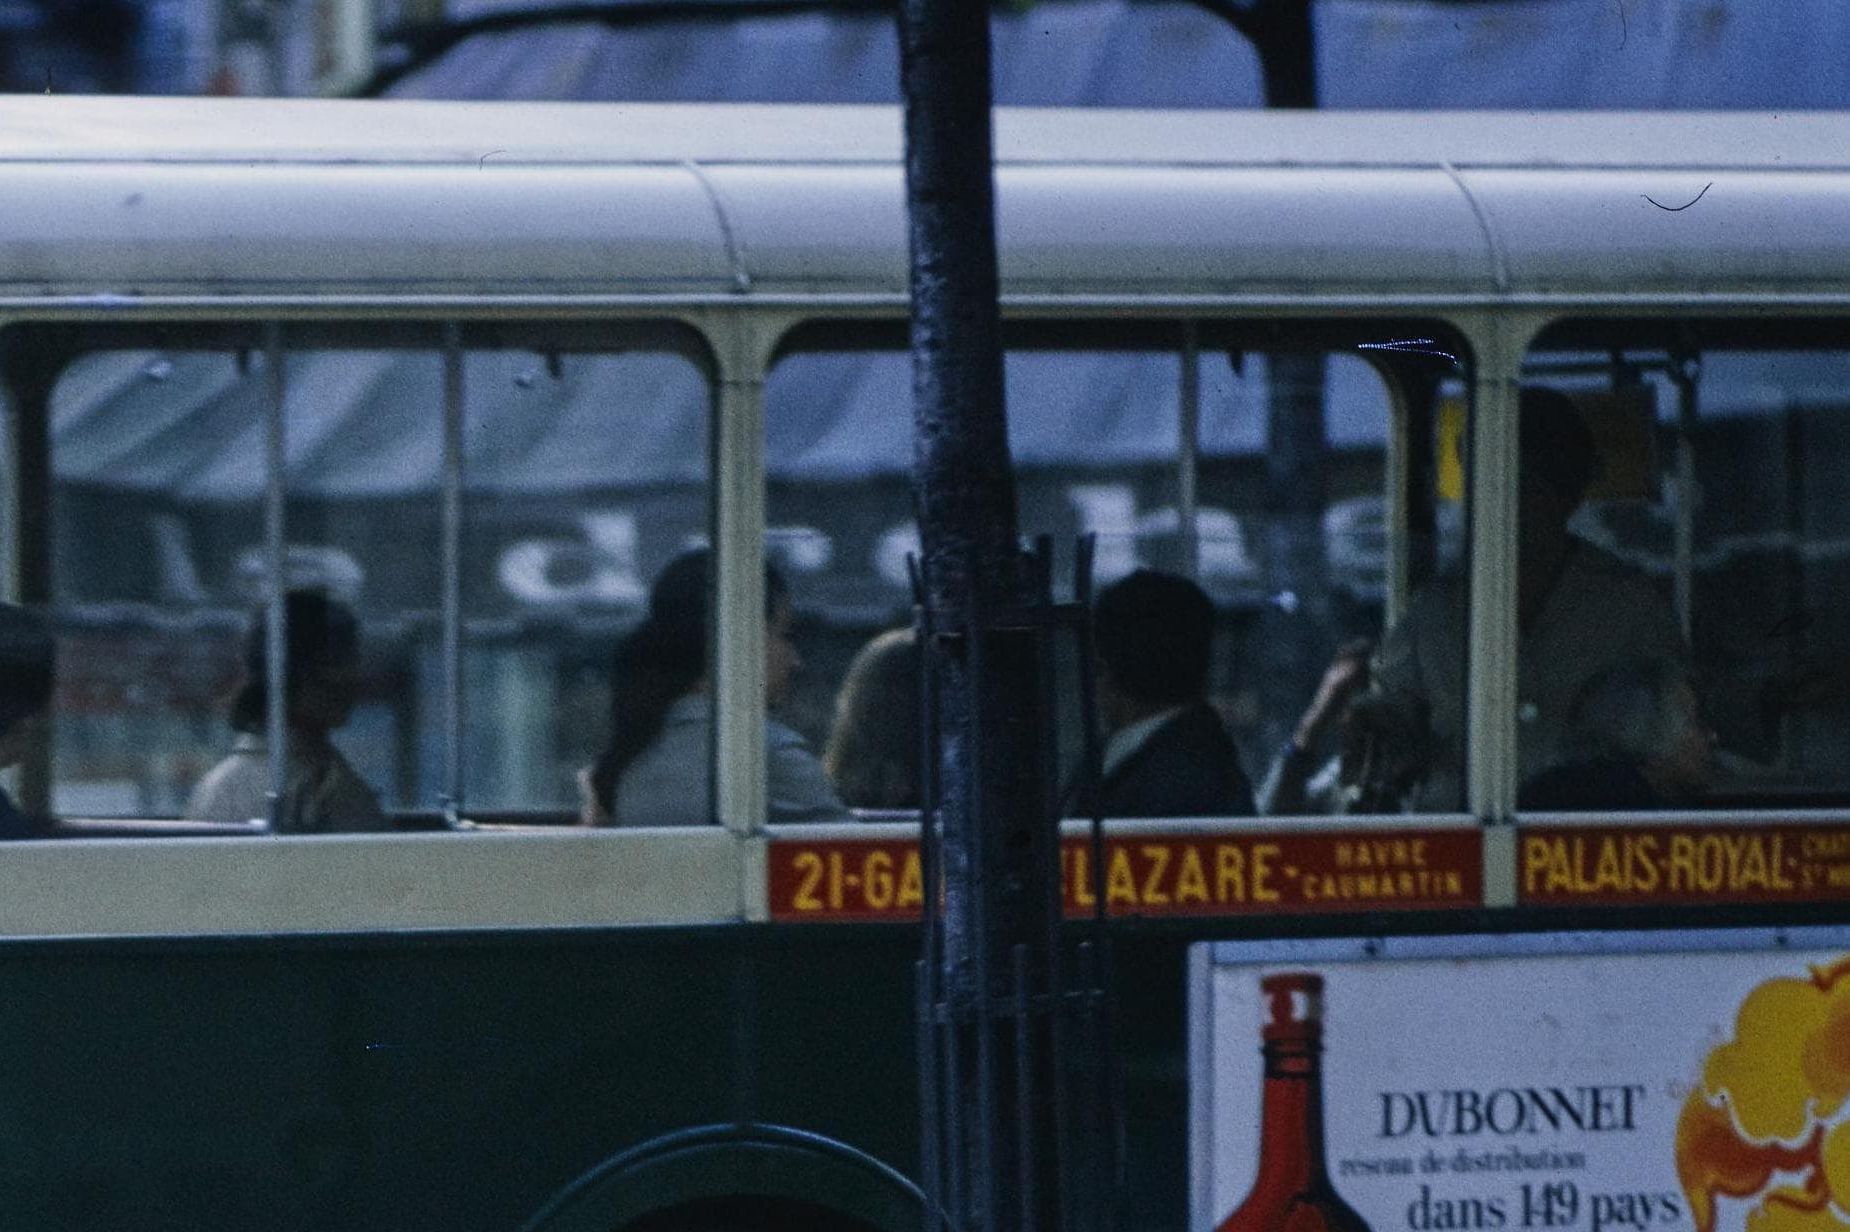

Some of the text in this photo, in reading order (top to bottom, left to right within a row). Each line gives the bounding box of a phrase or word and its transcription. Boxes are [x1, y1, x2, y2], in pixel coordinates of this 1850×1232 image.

[1418, 1148, 1445, 1174] de
[1448, 1145, 1586, 1173] distribution
[1407, 1184, 1506, 1231] dans
[1519, 1179, 1579, 1227] 149
